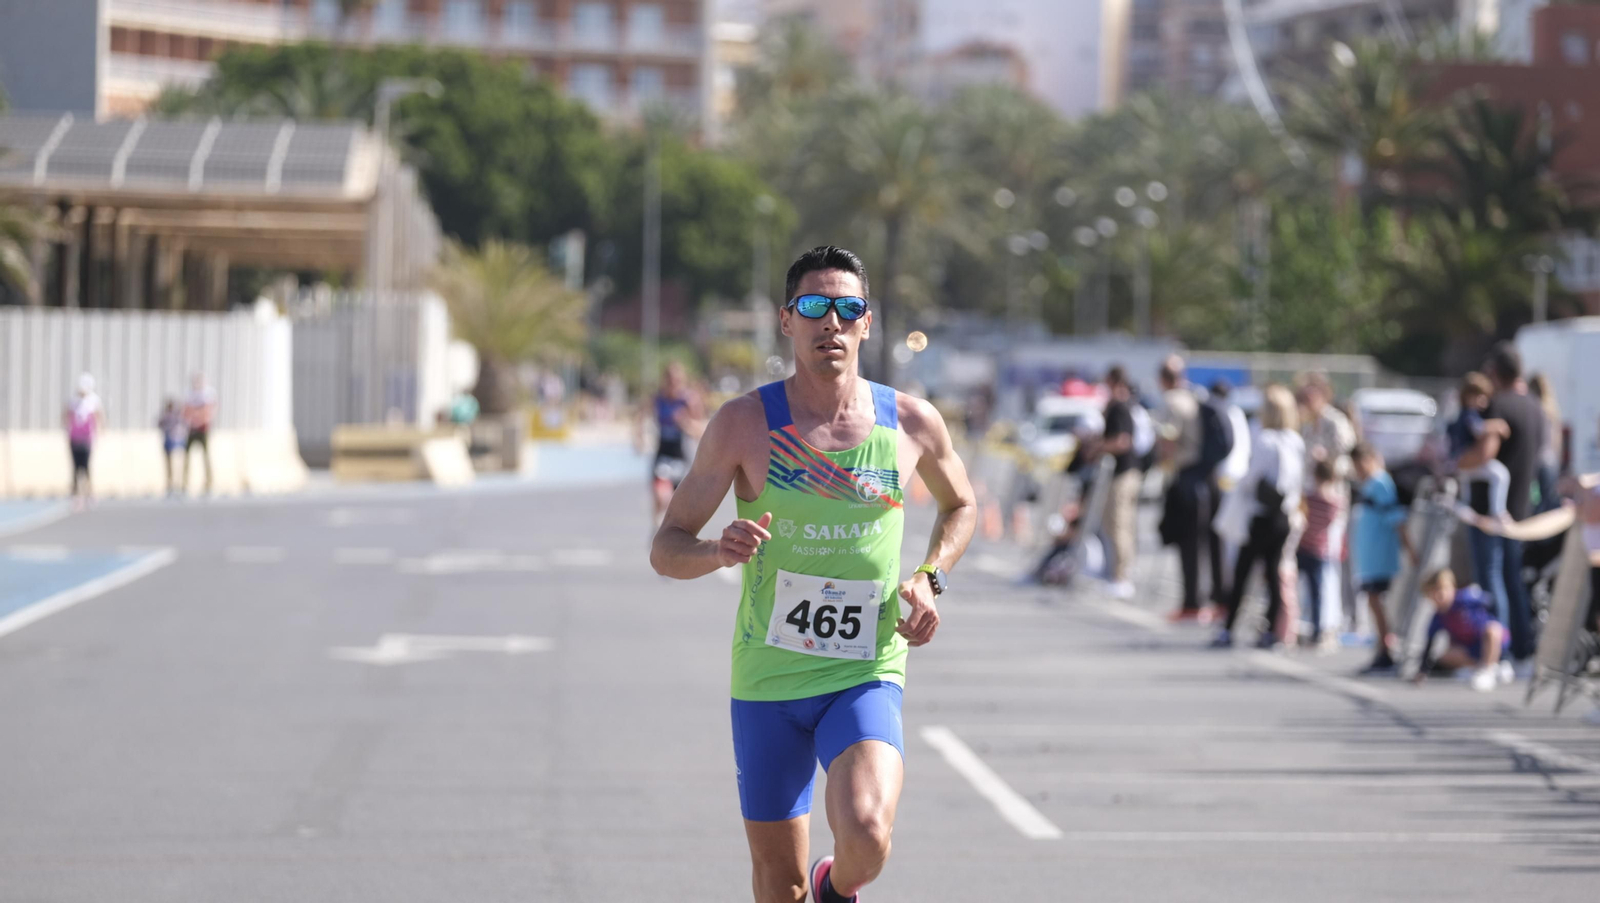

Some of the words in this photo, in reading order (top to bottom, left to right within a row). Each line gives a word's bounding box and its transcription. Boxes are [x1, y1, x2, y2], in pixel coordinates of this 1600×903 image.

[803, 519, 883, 540] SAKATA
[838, 547, 847, 555] in
[849, 543, 872, 555] Seed
[785, 599, 863, 640] 465
